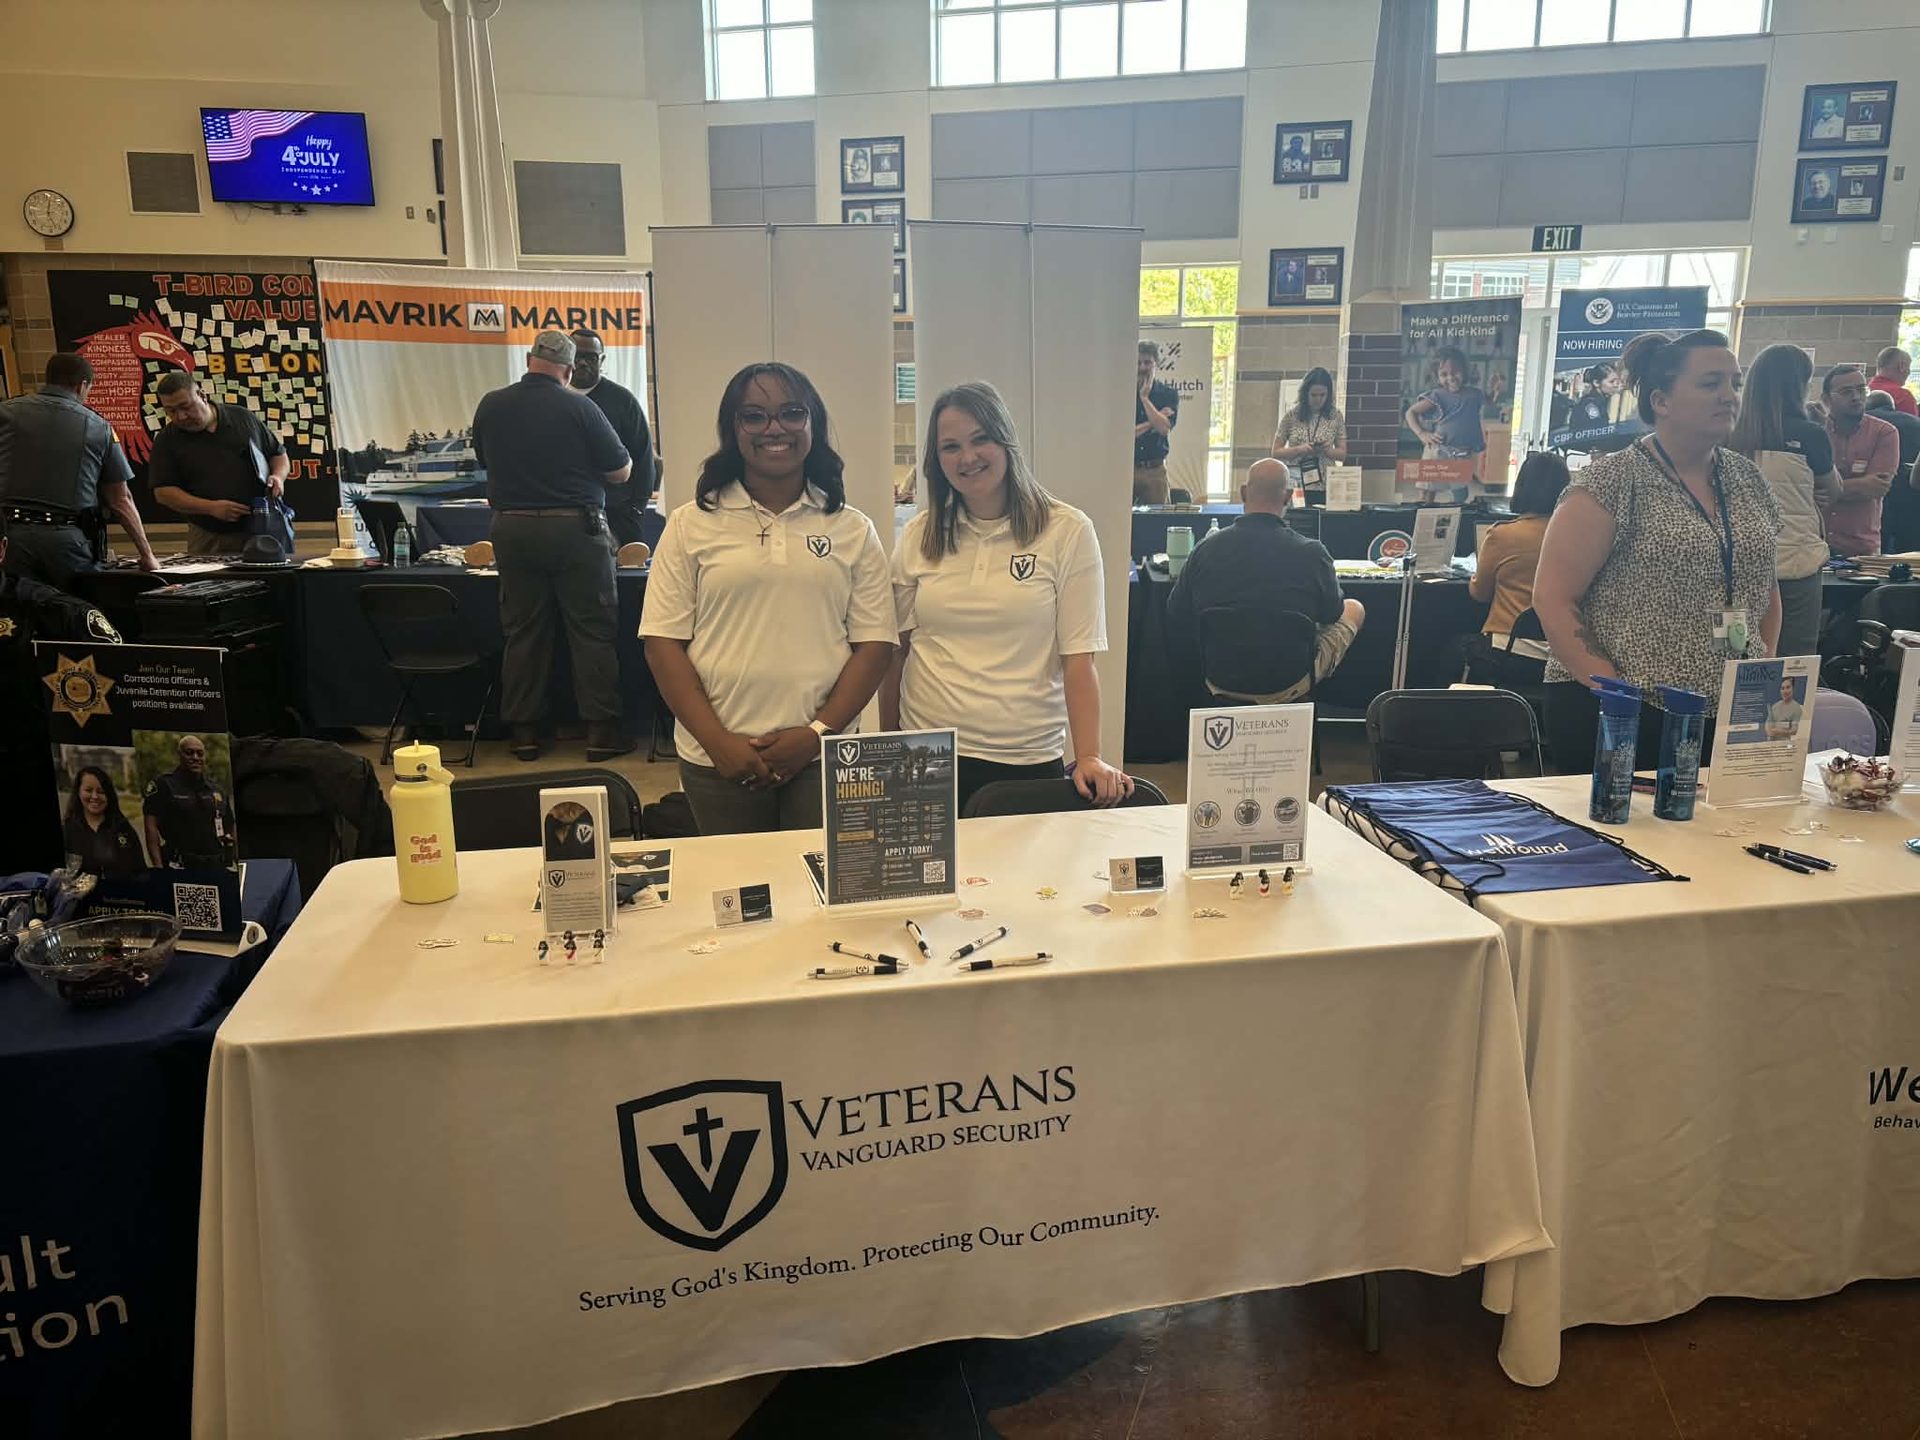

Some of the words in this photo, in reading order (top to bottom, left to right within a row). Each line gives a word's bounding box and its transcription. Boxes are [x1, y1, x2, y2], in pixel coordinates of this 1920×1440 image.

[306, 135, 332, 151] Happy
[299, 152, 340, 167] JULY
[1542, 227, 1575, 250] EXIT
[153, 274, 254, 297] T-BIRD
[325, 298, 463, 328] MAVRIK
[511, 306, 642, 331] MARINE
[1410, 316, 1438, 327] Make
[1441, 317, 1448, 325] a
[1451, 314, 1510, 325] Difference
[1409, 329, 1425, 338] for
[1428, 328, 1443, 338] All
[1447, 326, 1497, 337] Kid-Kind
[87, 345, 132, 353] KINDNESS
[1562, 340, 1587, 350] NOW
[1588, 339, 1623, 350] HIRING
[109, 387, 139, 396] HOPE
[1554, 432, 1572, 443] CBP
[1575, 425, 1615, 440] OFFICER
[123, 674, 169, 685] Corrections
[170, 675, 201, 686] Officers
[203, 677, 210, 686] &
[116, 686, 149, 696] Juvenile
[149, 688, 188, 698] Detention
[189, 690, 221, 699] Officers
[132, 700, 168, 710] positions
[1235, 719, 1289, 730] VETERANS
[862, 742, 902, 751] VETERANS
[835, 766, 875, 783] WE'RE
[836, 780, 884, 799] HIRING!
[885, 847, 906, 857] APPLY
[908, 845, 933, 855] TODAY!
[788, 1065, 1076, 1140] VETERANS
[801, 1132, 946, 1171] VANGUARD
[953, 1114, 1071, 1146] SECURITY
[579, 1286, 666, 1311] Serving
[671, 1267, 738, 1298] God's
[743, 1256, 856, 1285] Kingdom.
[862, 1232, 973, 1267] Protecting
[978, 1226, 1024, 1246] Our
[1030, 1205, 1160, 1242] Community.
